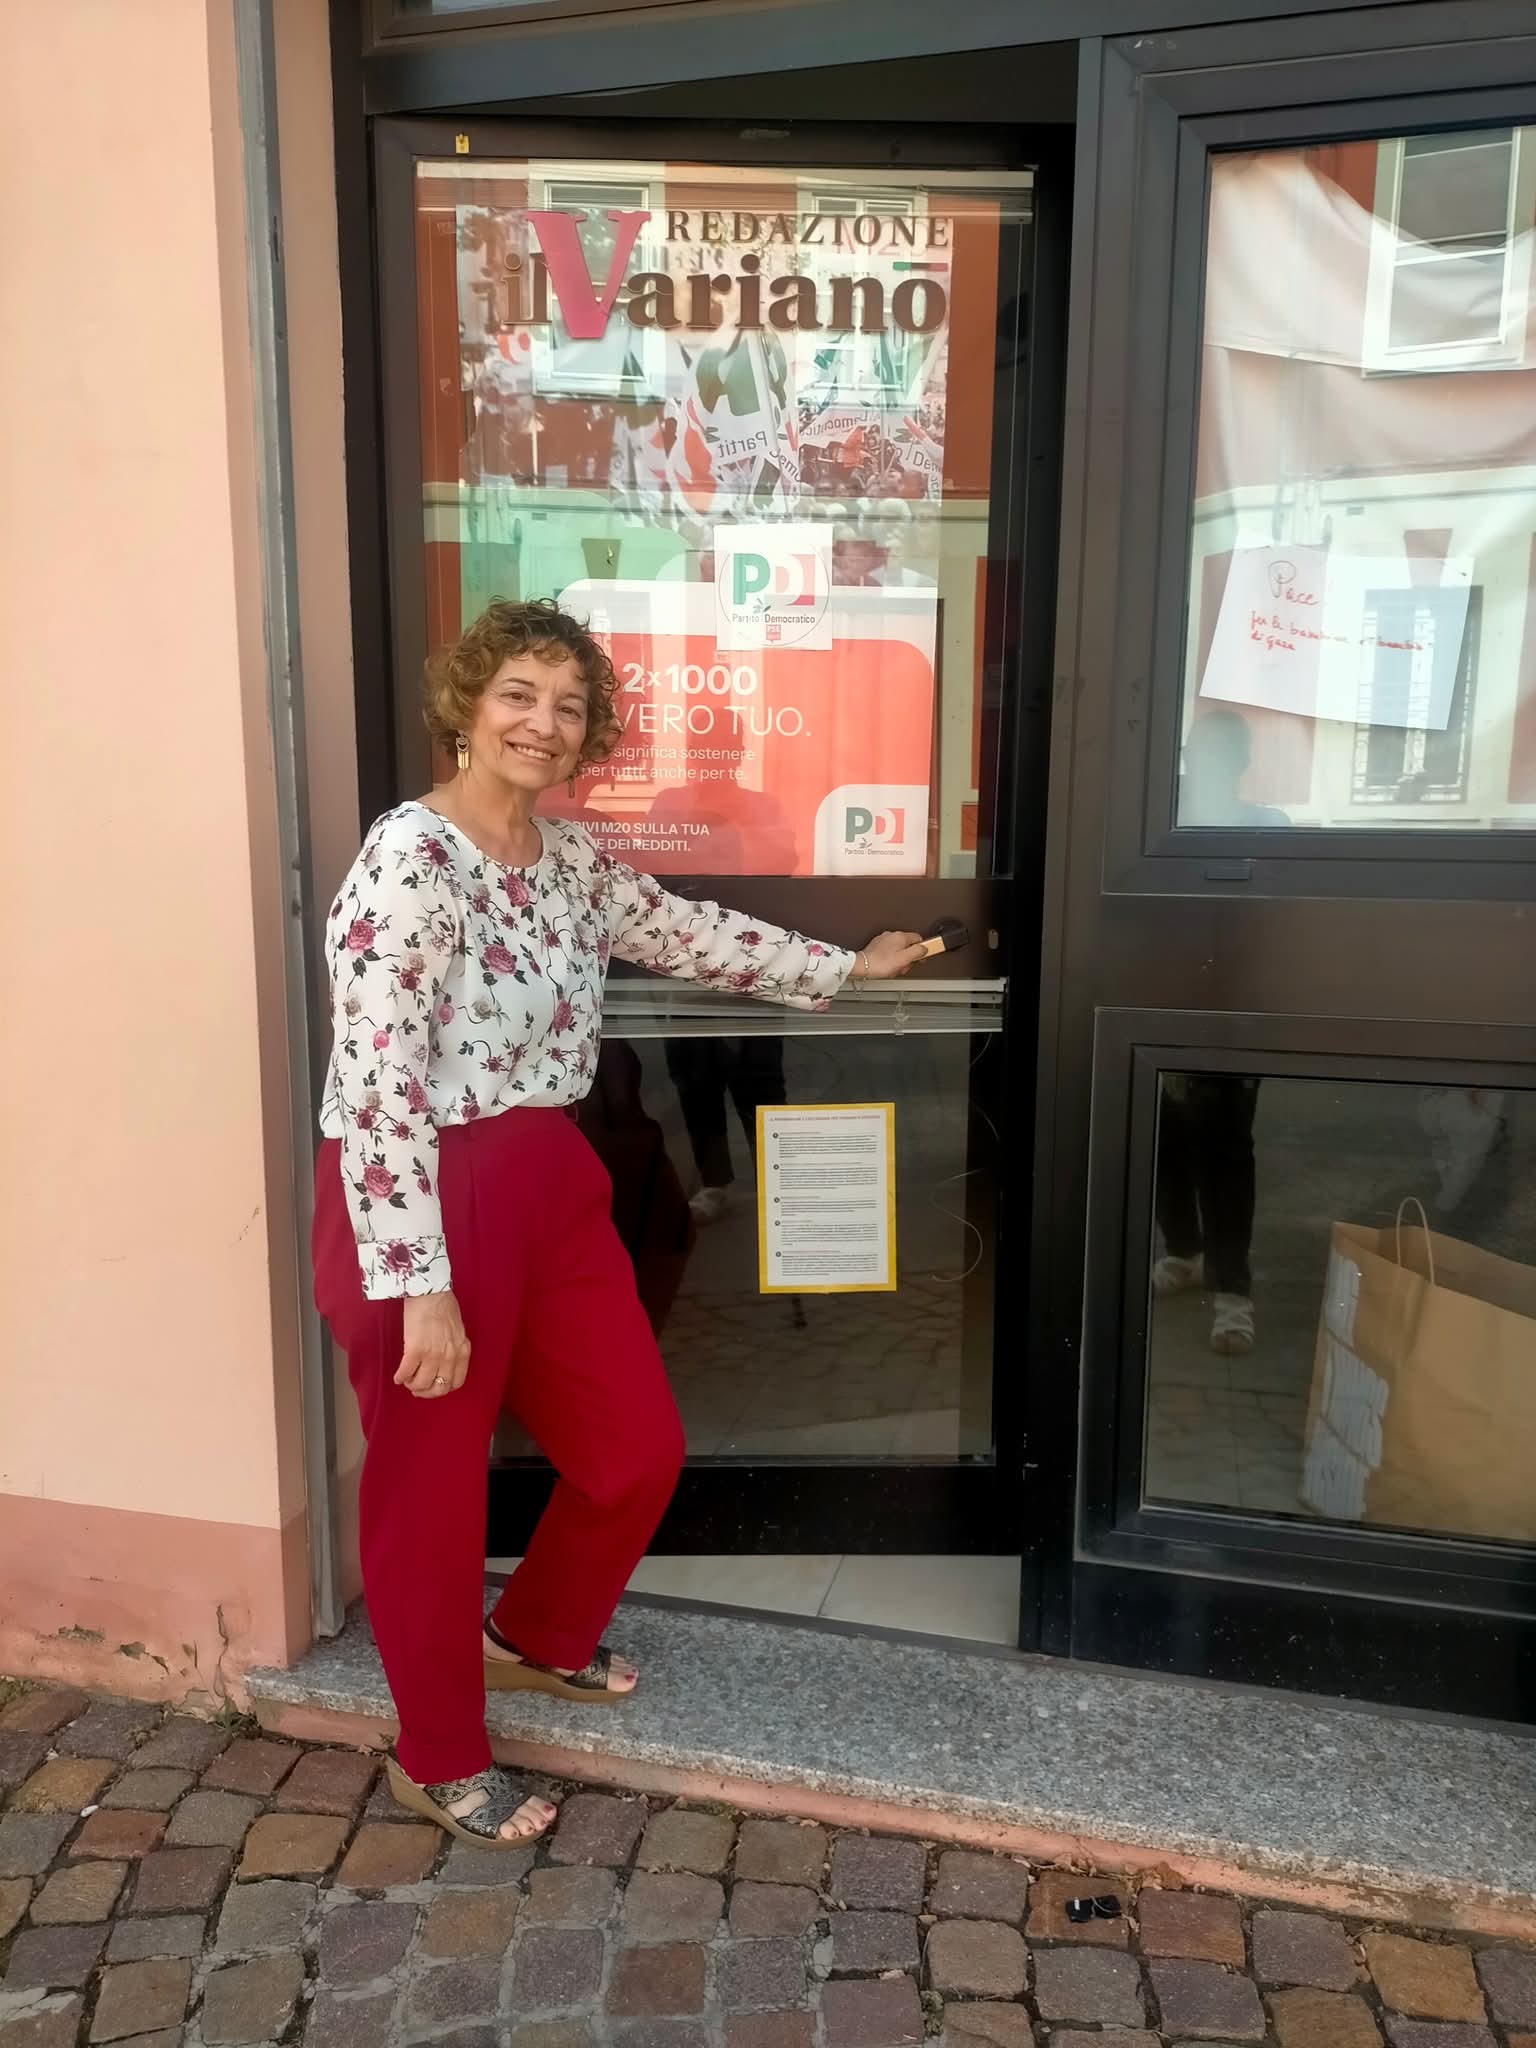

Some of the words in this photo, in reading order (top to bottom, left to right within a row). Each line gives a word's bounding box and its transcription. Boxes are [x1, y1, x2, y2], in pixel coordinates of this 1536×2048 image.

[666, 210, 949, 248] REDAZIONE
[733, 553, 816, 606] PD
[764, 613, 816, 624] Democratico
[724, 705, 812, 737] TUO.
[614, 743, 678, 760] significa
[680, 747, 756, 761] sostenere
[582, 765, 607, 779] per
[650, 765, 697, 779] anche
[700, 767, 726, 782] per
[601, 821, 631, 834] M20
[633, 822, 679, 835] SULLA
[680, 823, 710, 836] TUA
[845, 806, 905, 844] PD
[607, 838, 630, 850] DEI
[632, 838, 692, 852] REDDITI.
